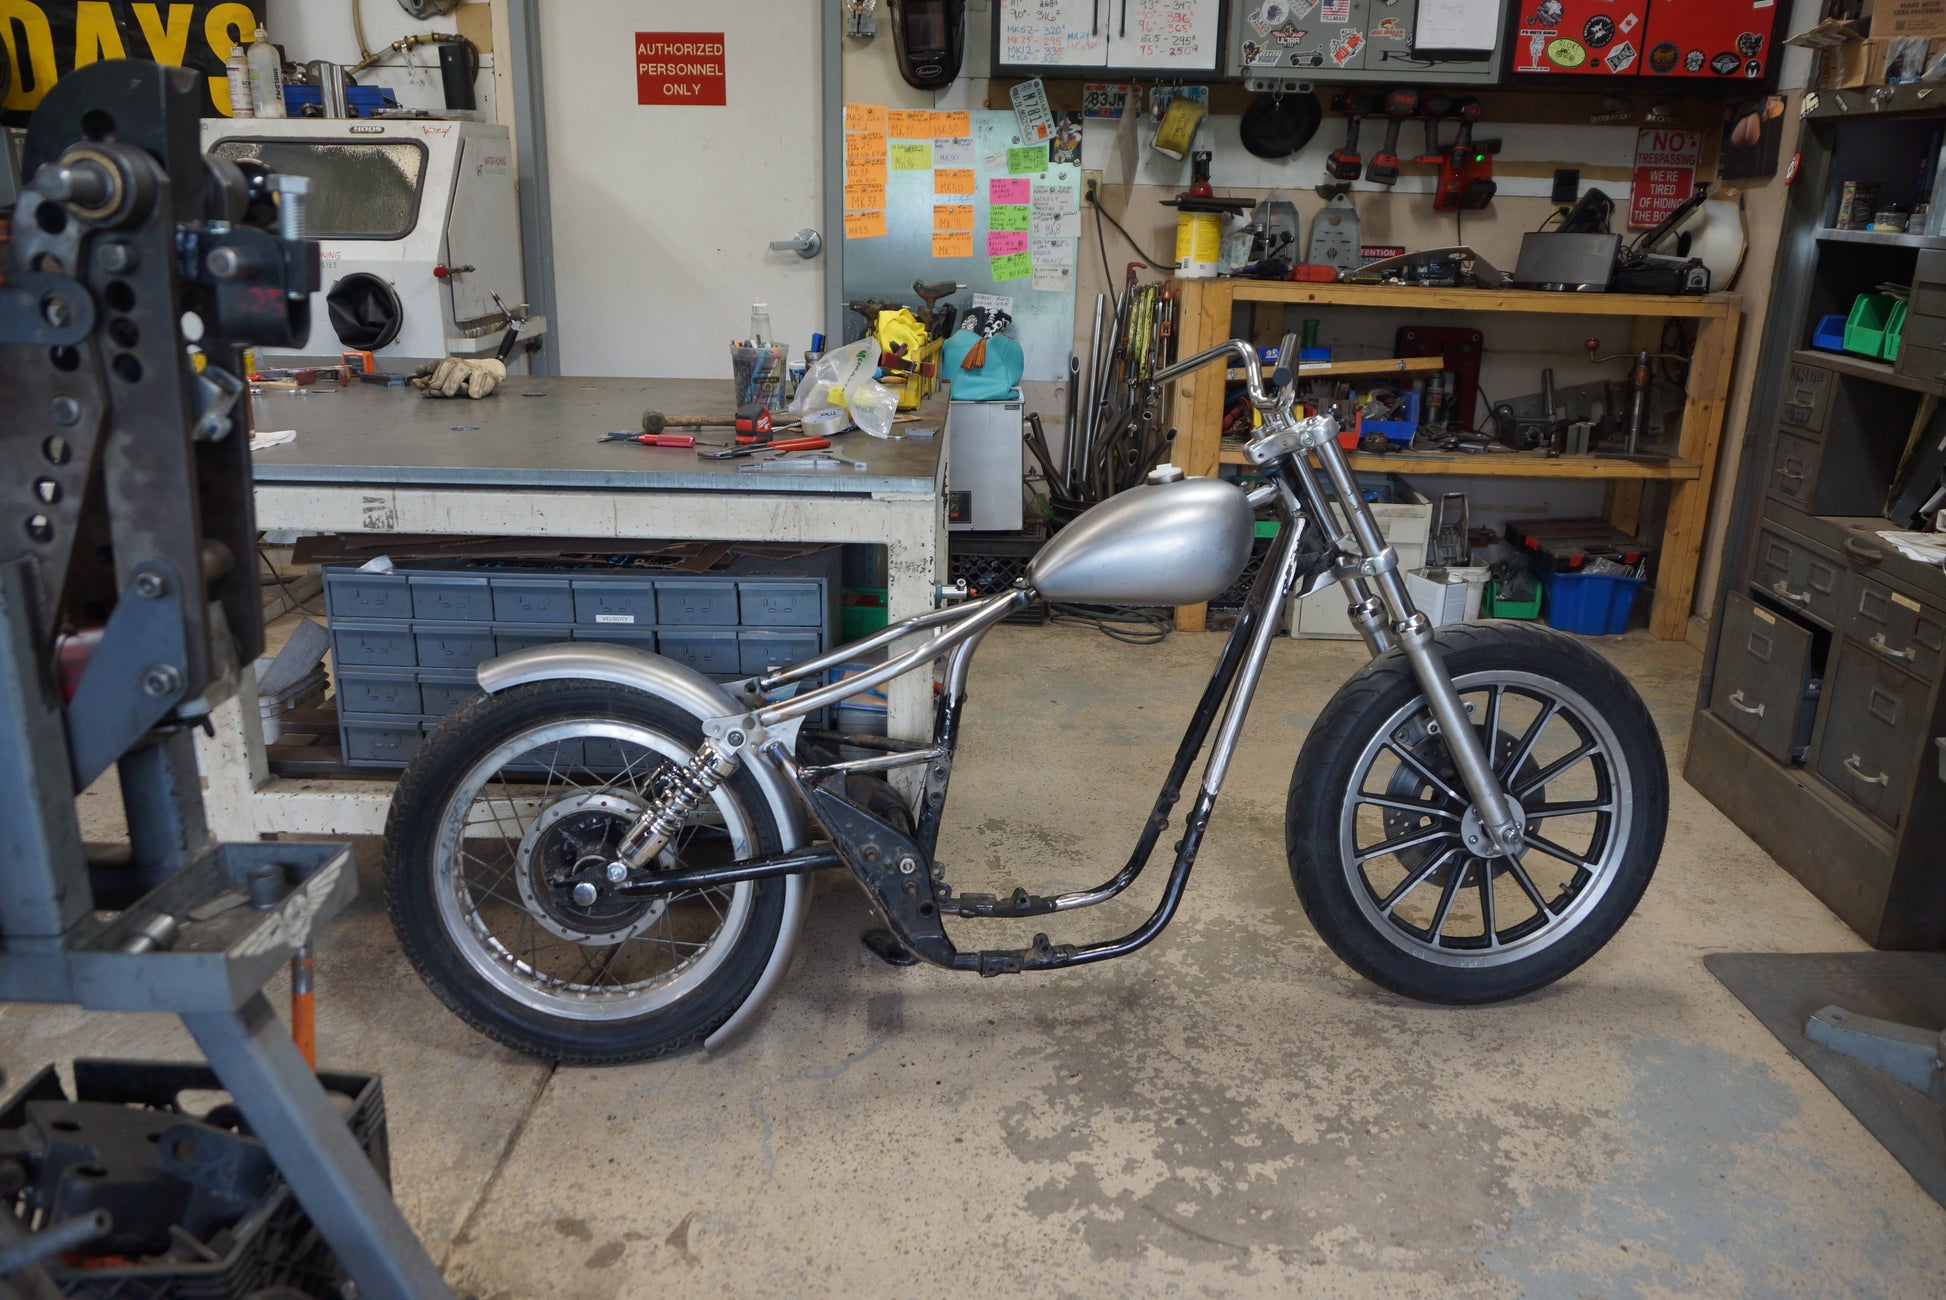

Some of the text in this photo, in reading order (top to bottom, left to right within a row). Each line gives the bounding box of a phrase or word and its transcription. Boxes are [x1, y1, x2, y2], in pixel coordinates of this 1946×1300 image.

[638, 43, 723, 55] AUTHORIZED
[639, 63, 723, 75] PERSONNEL
[663, 83, 701, 95] ONLY
[1653, 132, 1685, 151] NO
[1638, 152, 1696, 166] TRESPASSING
[1650, 170, 1679, 182] WE'RE
[1651, 184, 1676, 195] TIRED
[1640, 197, 1651, 208] OF
[1634, 210, 1651, 221] THE
[1360, 249, 1396, 257] TENTION
